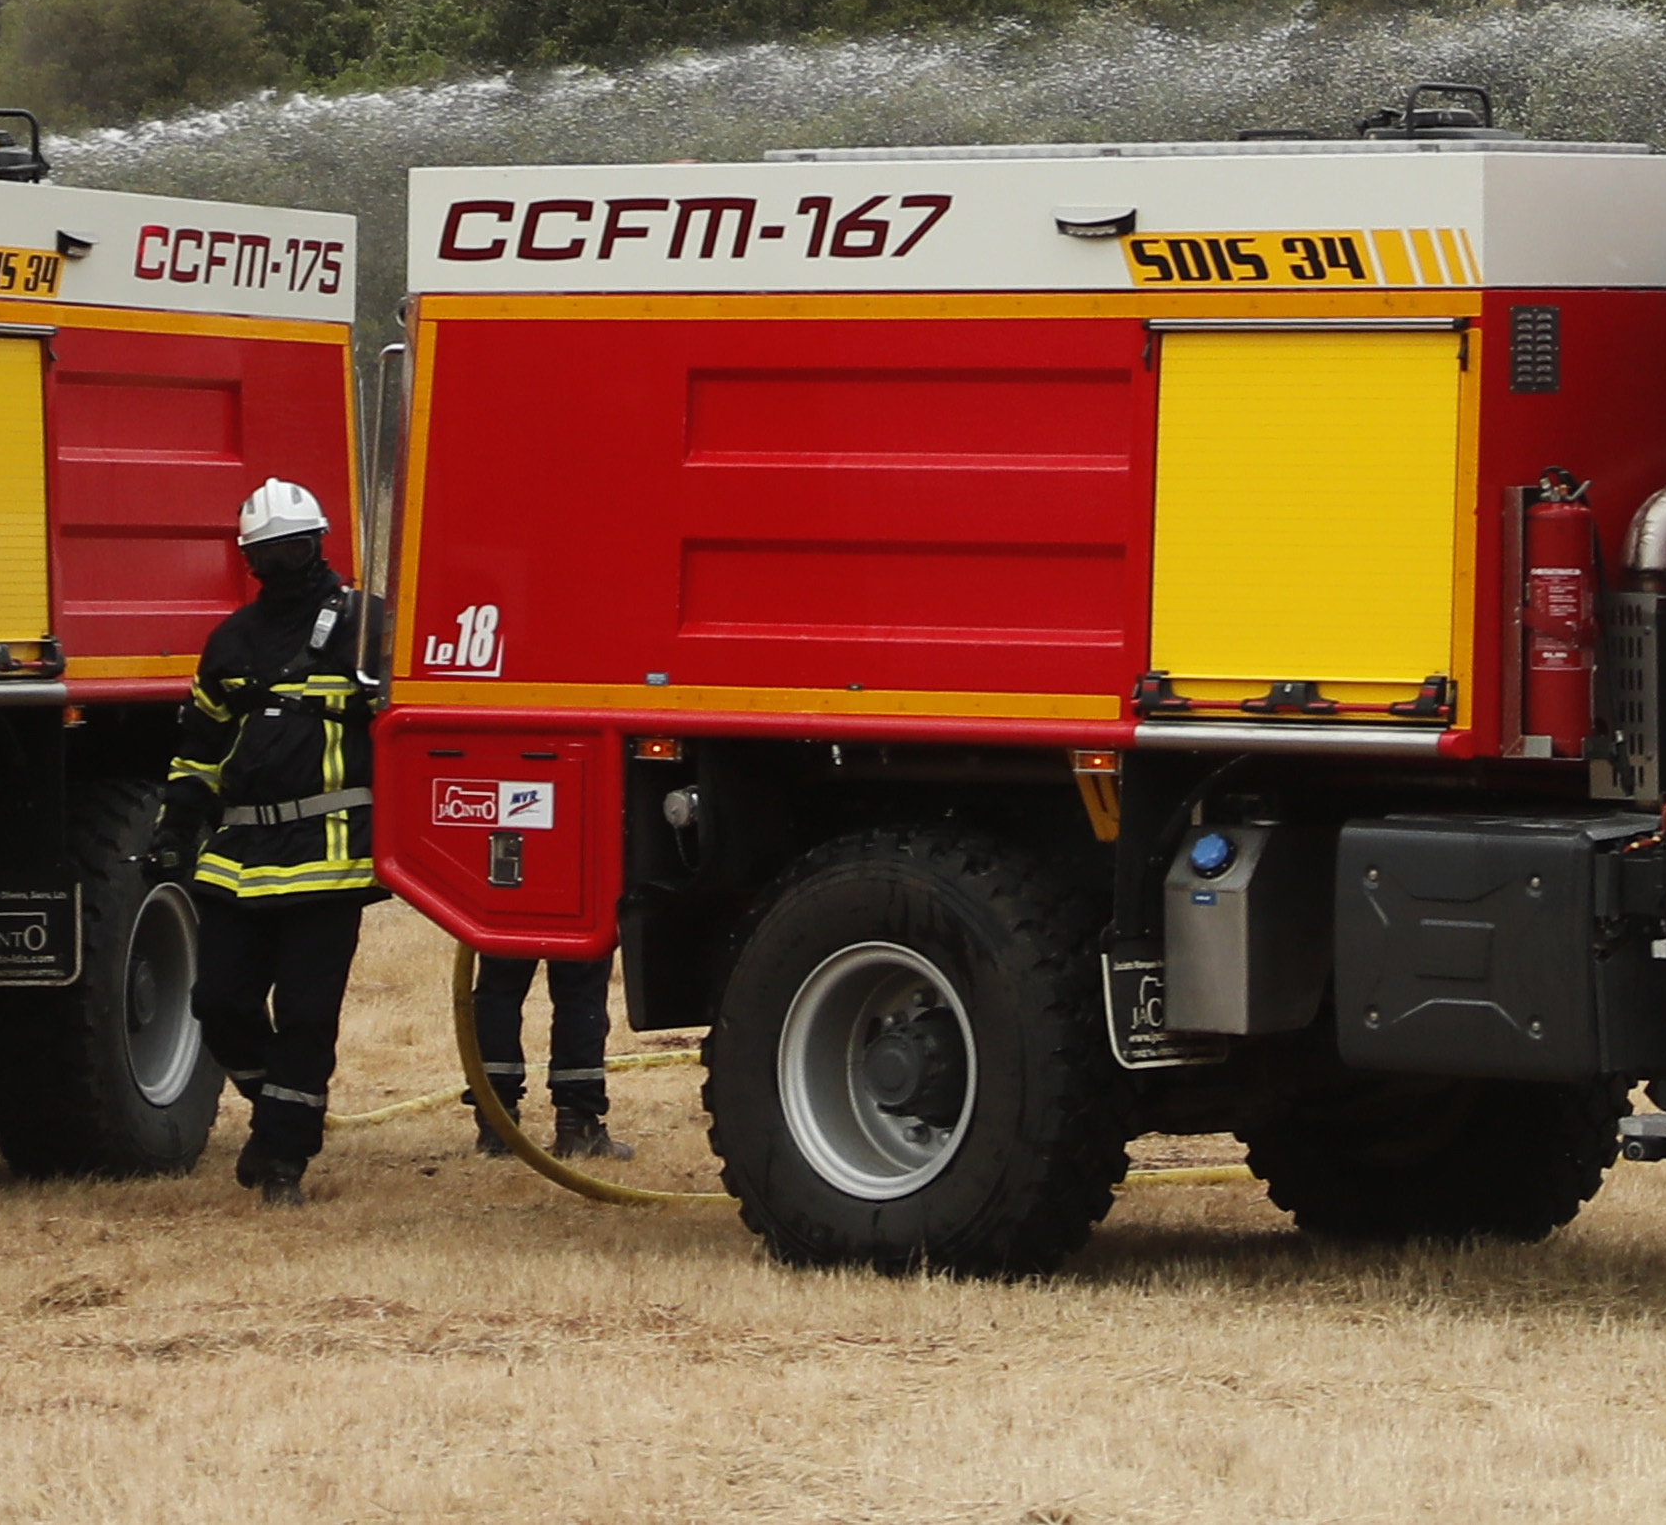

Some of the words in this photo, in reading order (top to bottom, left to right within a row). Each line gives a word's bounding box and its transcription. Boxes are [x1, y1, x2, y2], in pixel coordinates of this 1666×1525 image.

[134, 225, 345, 295] CCFM-175
[436, 194, 954, 262] CCFM-167
[1129, 238, 1270, 282] SDIS
[1281, 237, 1367, 281] 34
[24, 254, 60, 294] 34
[424, 635, 454, 665] Le
[454, 604, 499, 668] 18
